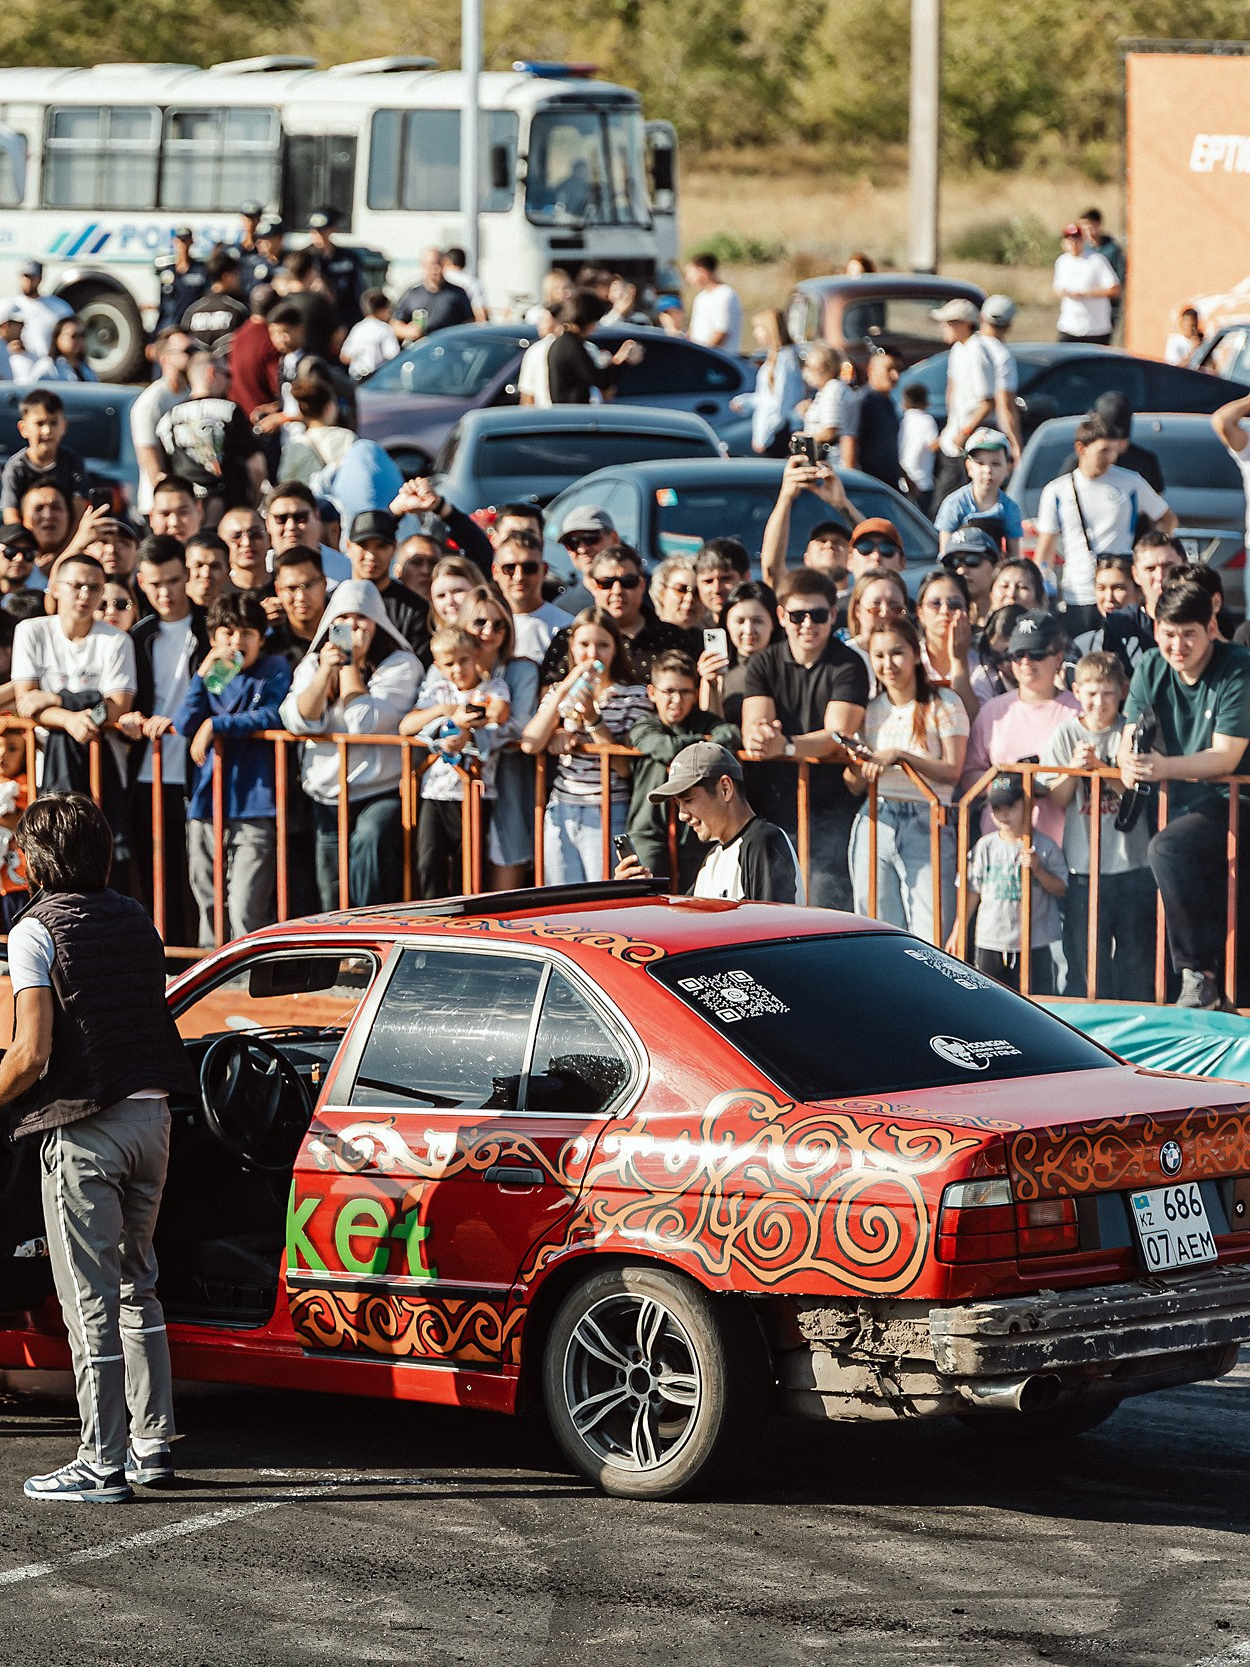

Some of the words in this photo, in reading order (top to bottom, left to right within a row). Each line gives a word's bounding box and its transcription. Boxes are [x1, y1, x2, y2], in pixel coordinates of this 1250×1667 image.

[1139, 1212, 1155, 1227] KZ
[1163, 1185, 1203, 1222] 686
[1146, 1233, 1171, 1266] 07
[1177, 1230, 1216, 1262] AEM
